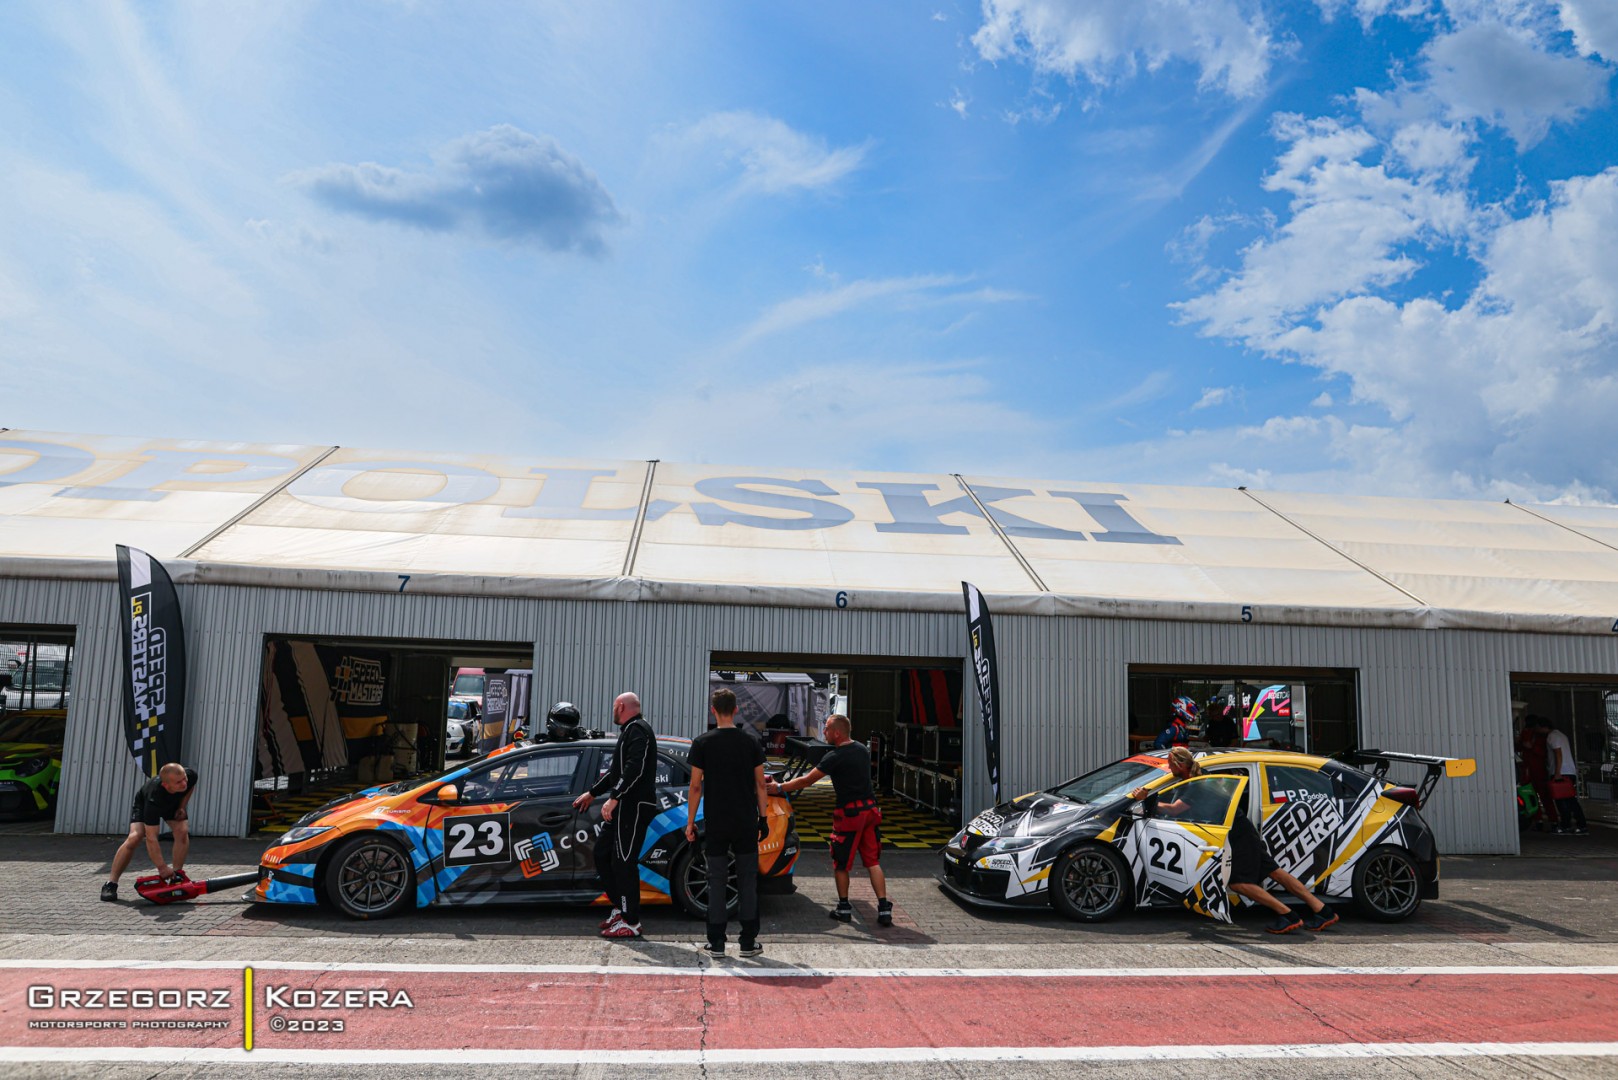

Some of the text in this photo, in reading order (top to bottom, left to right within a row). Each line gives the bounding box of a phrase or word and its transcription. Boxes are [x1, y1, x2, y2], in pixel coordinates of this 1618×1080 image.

[398, 574, 411, 592] 7
[835, 590, 848, 609] 6
[1241, 605, 1252, 622] 5
[1298, 788, 1328, 801] Podoba
[448, 821, 504, 858] 23
[1149, 837, 1184, 876] 22
